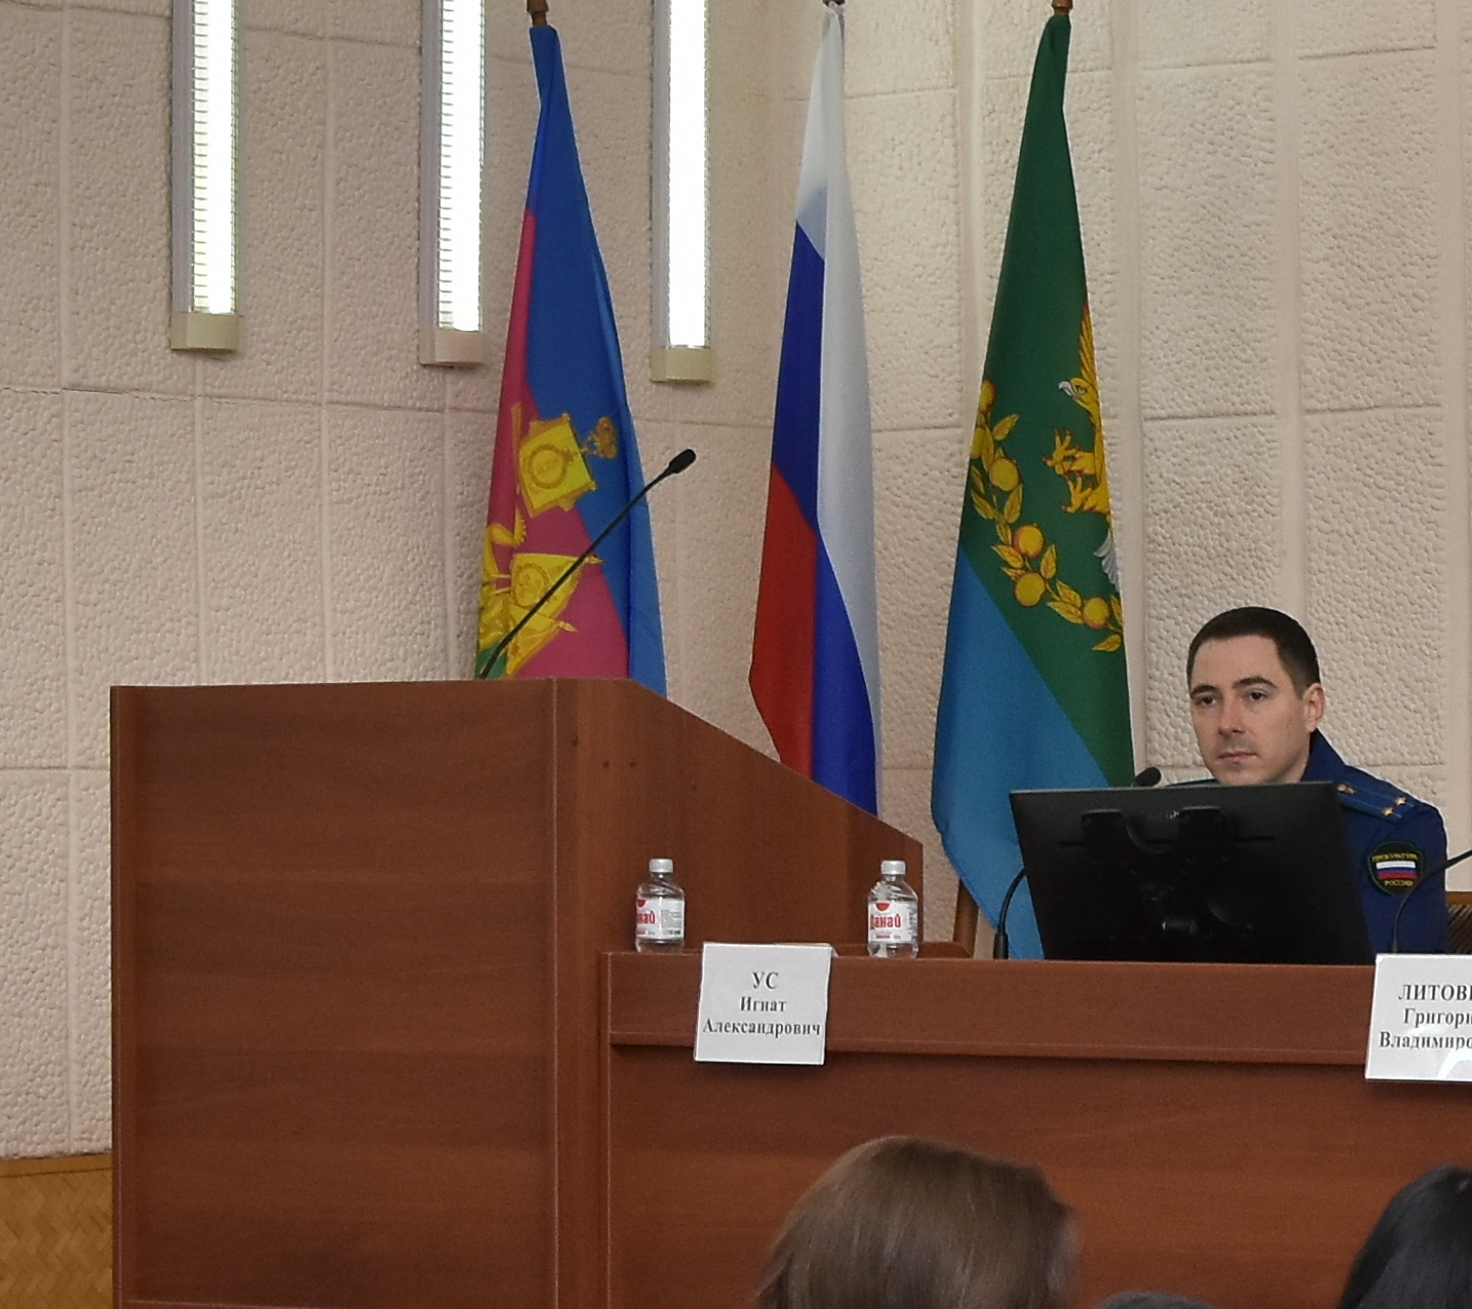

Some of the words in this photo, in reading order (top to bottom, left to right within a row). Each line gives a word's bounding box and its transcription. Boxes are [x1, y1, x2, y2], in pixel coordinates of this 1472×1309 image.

[752, 972, 779, 990] УС
[740, 996, 787, 1013] Игнат
[702, 1018, 821, 1038] Александрович
